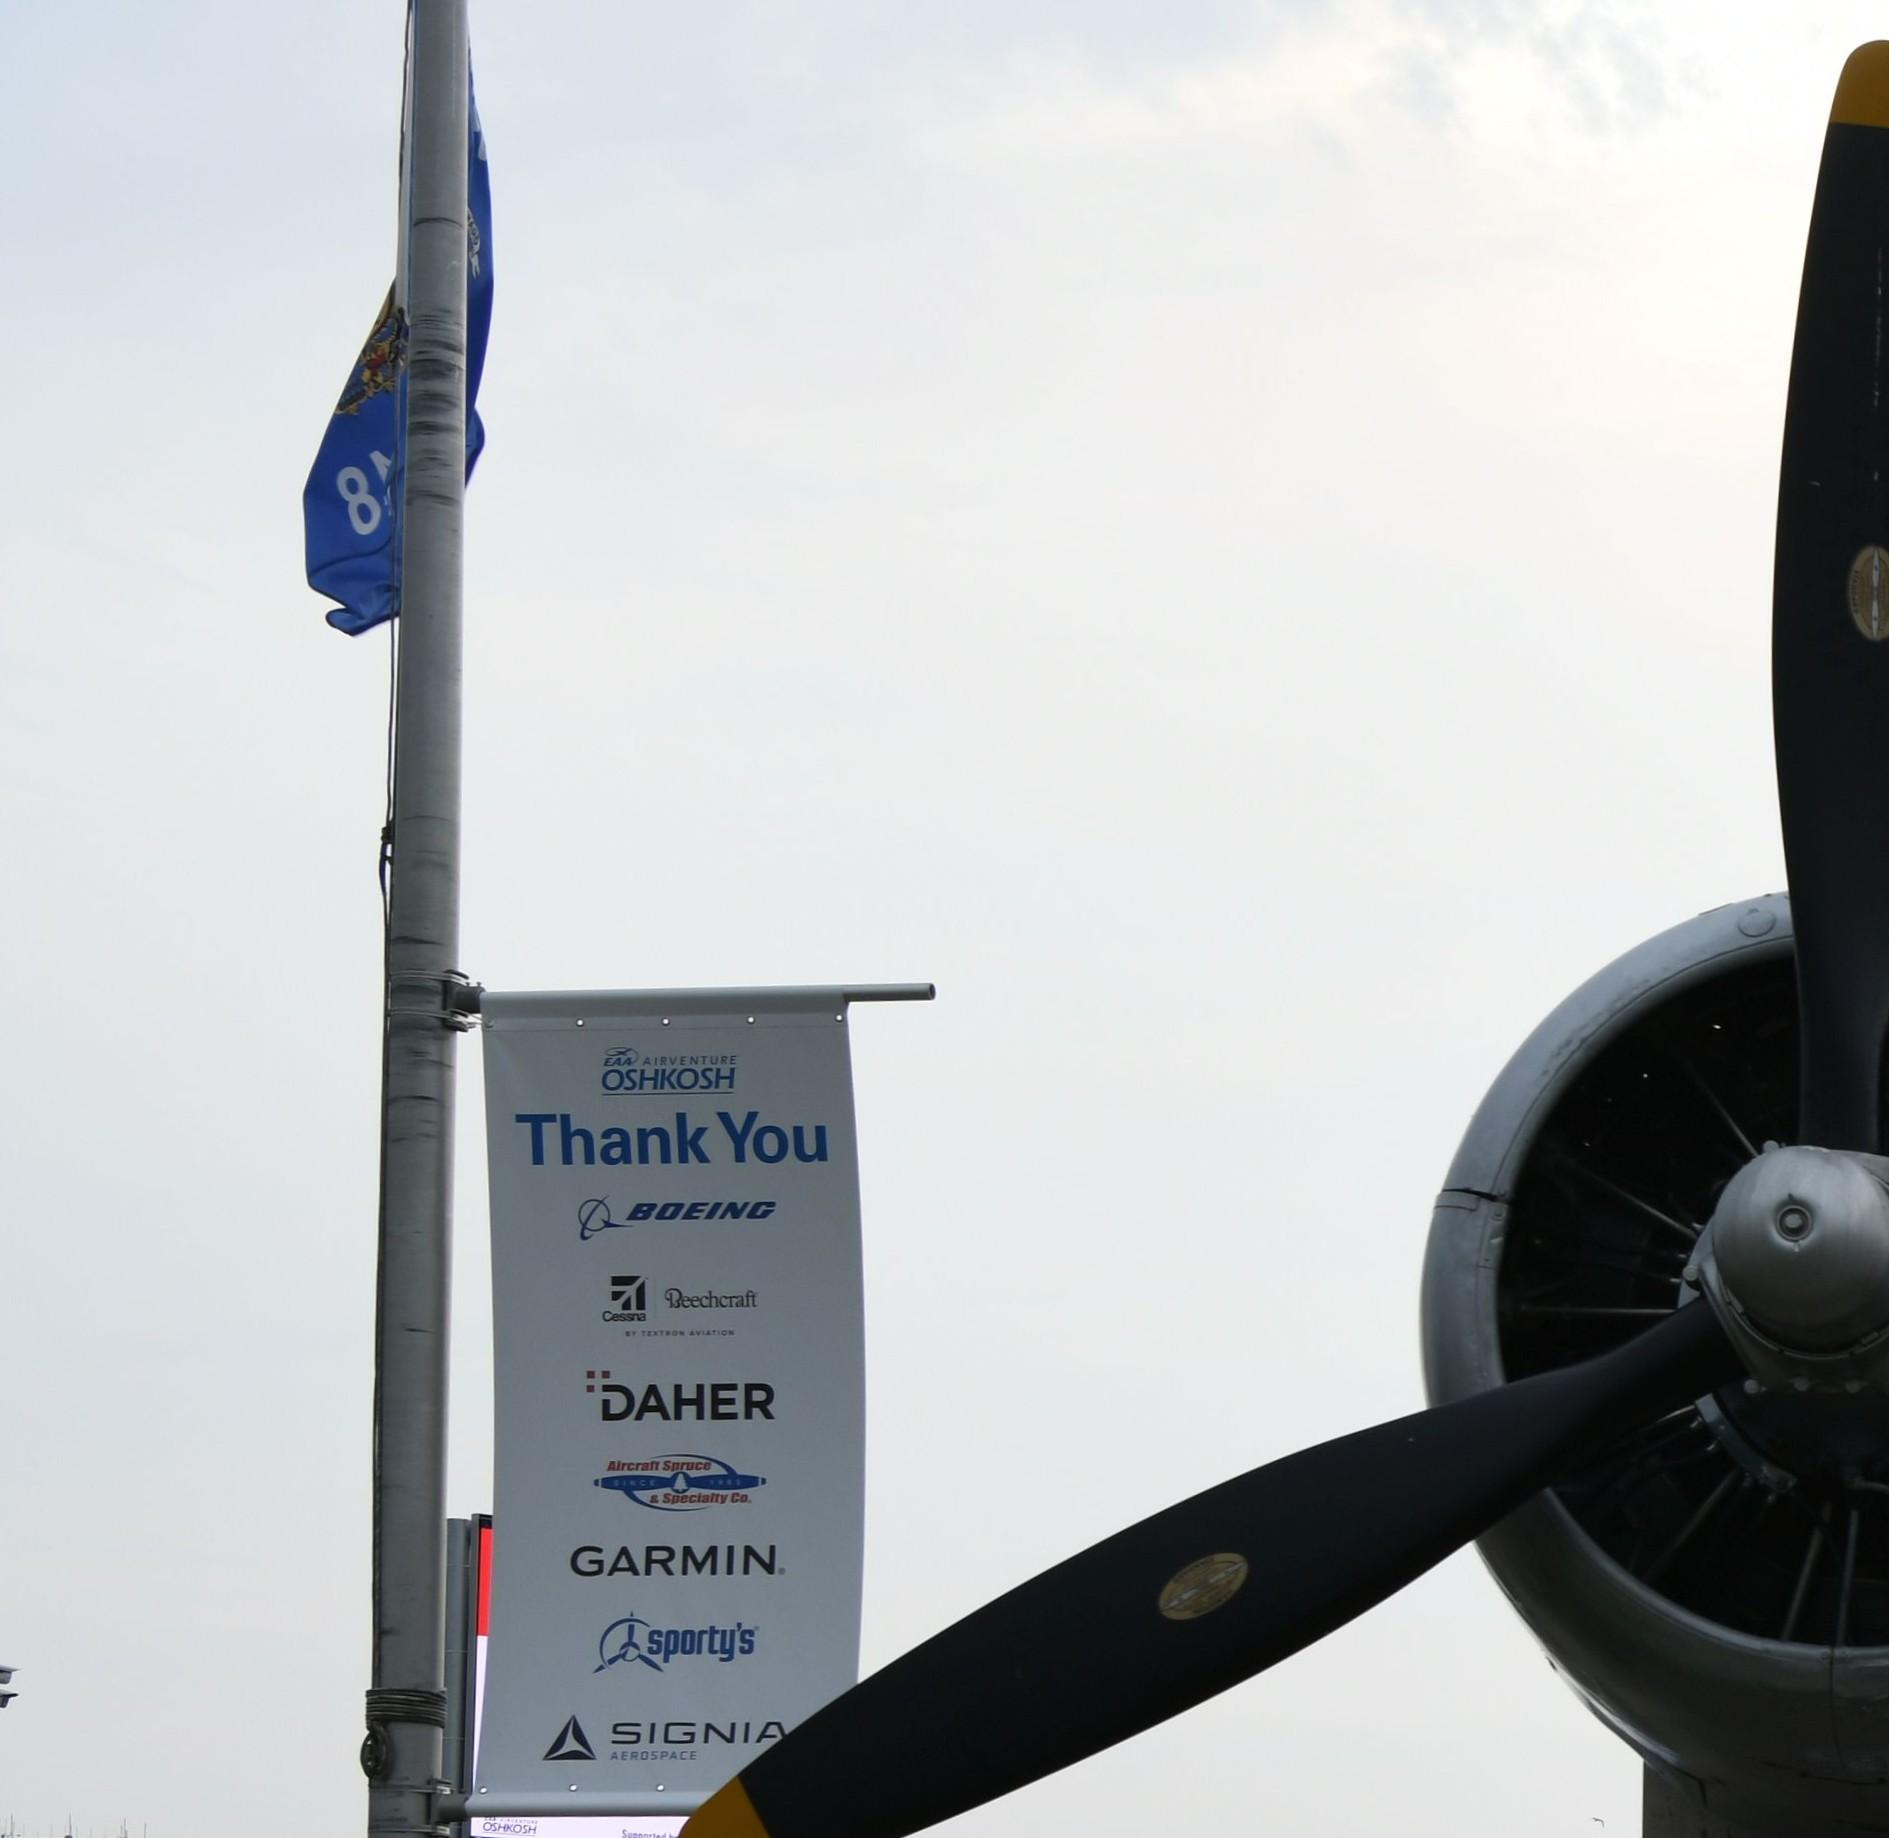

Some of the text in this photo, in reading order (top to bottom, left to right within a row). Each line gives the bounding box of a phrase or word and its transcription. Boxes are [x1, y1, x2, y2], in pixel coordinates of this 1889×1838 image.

[603, 1055, 737, 1067] EAA AIRVENTURE
[601, 1068, 736, 1091] OSHKOSH
[515, 1111, 829, 1165] Thank You
[626, 1201, 777, 1221] BOEING
[664, 1287, 758, 1309] Beechcraft
[602, 1310, 647, 1322] Cessna
[641, 1329, 685, 1337] TEXTRON
[689, 1329, 735, 1337] AVIATION
[601, 1382, 775, 1421] DAHER
[606, 1460, 712, 1473] Aircraft Spruce
[649, 1492, 752, 1505] & Specialty Co.
[570, 1545, 777, 1577] GARMIN
[647, 1622, 756, 1662] sporty's
[610, 1721, 790, 1745] SIGNIA
[610, 1750, 698, 1761] AEROSPACE
[483, 1822, 537, 1835] OSHKOSH
